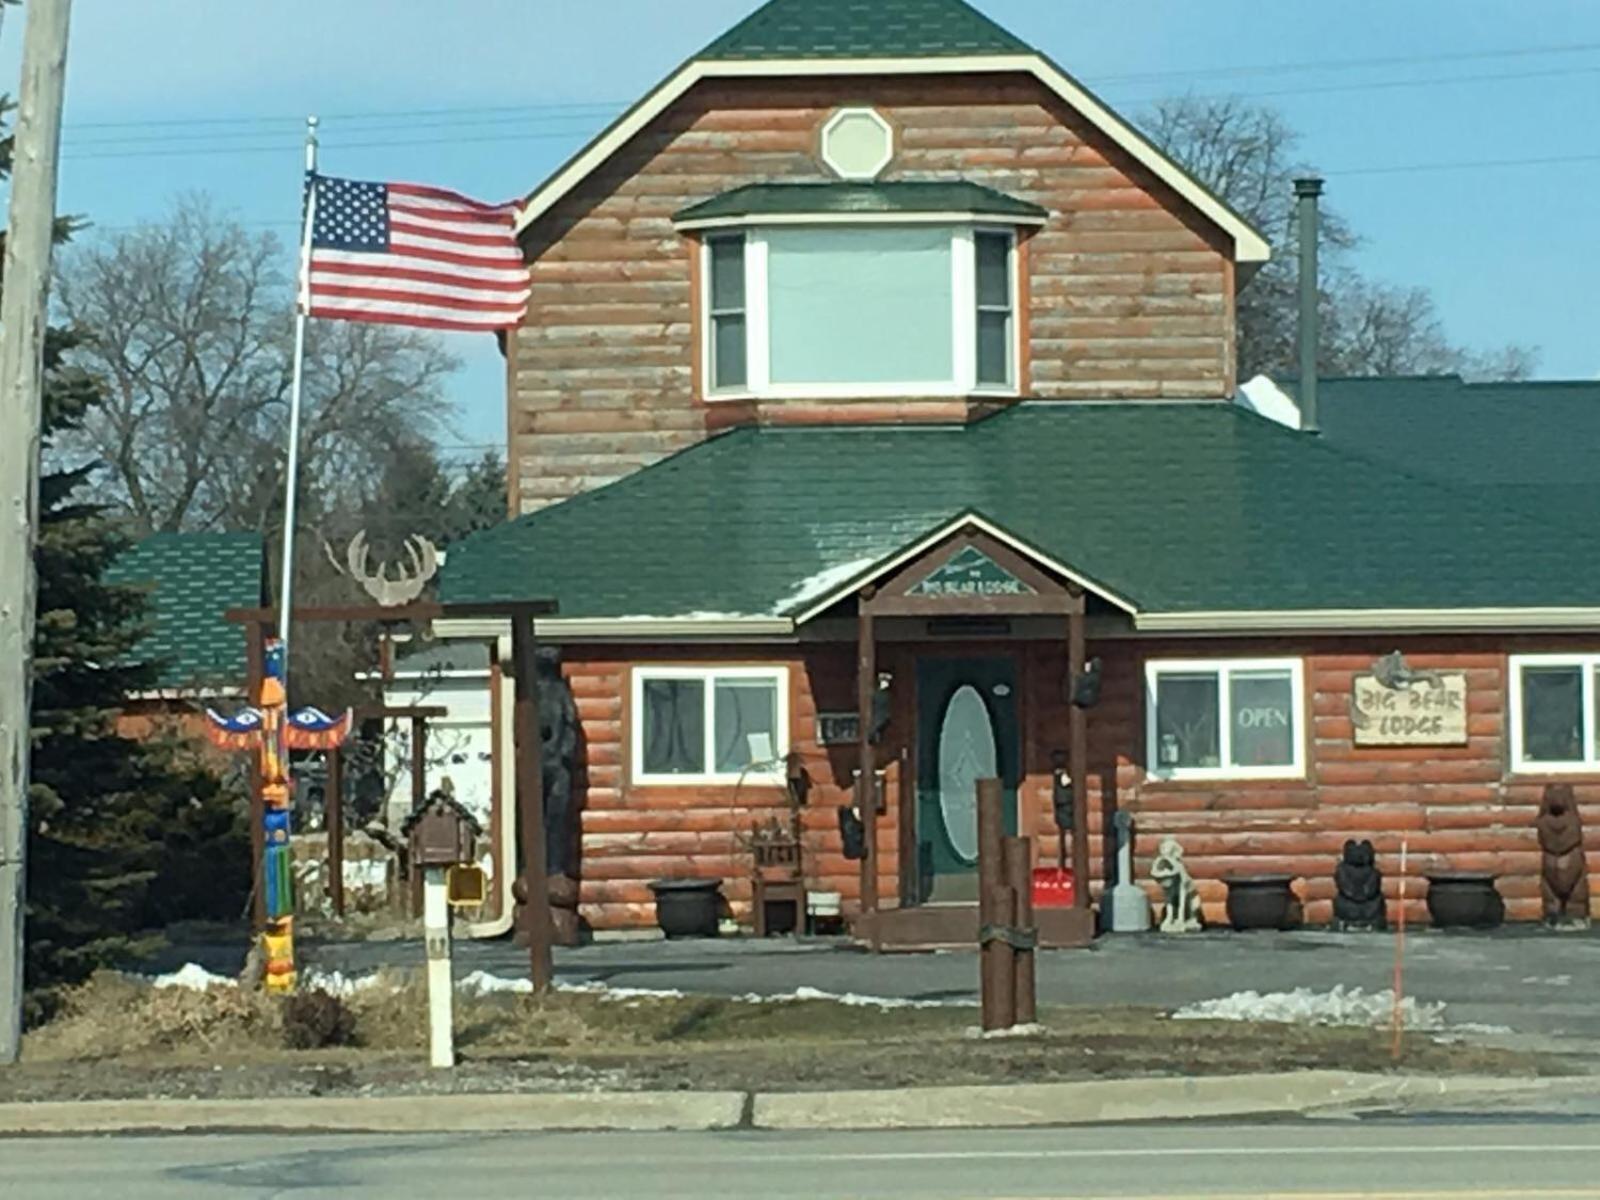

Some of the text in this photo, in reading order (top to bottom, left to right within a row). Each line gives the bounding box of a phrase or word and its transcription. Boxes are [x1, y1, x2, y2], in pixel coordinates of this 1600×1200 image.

[1361, 688, 1461, 711] BIG BEAR
[1238, 707, 1288, 728] OPEN
[1379, 715, 1442, 736] LODGE
